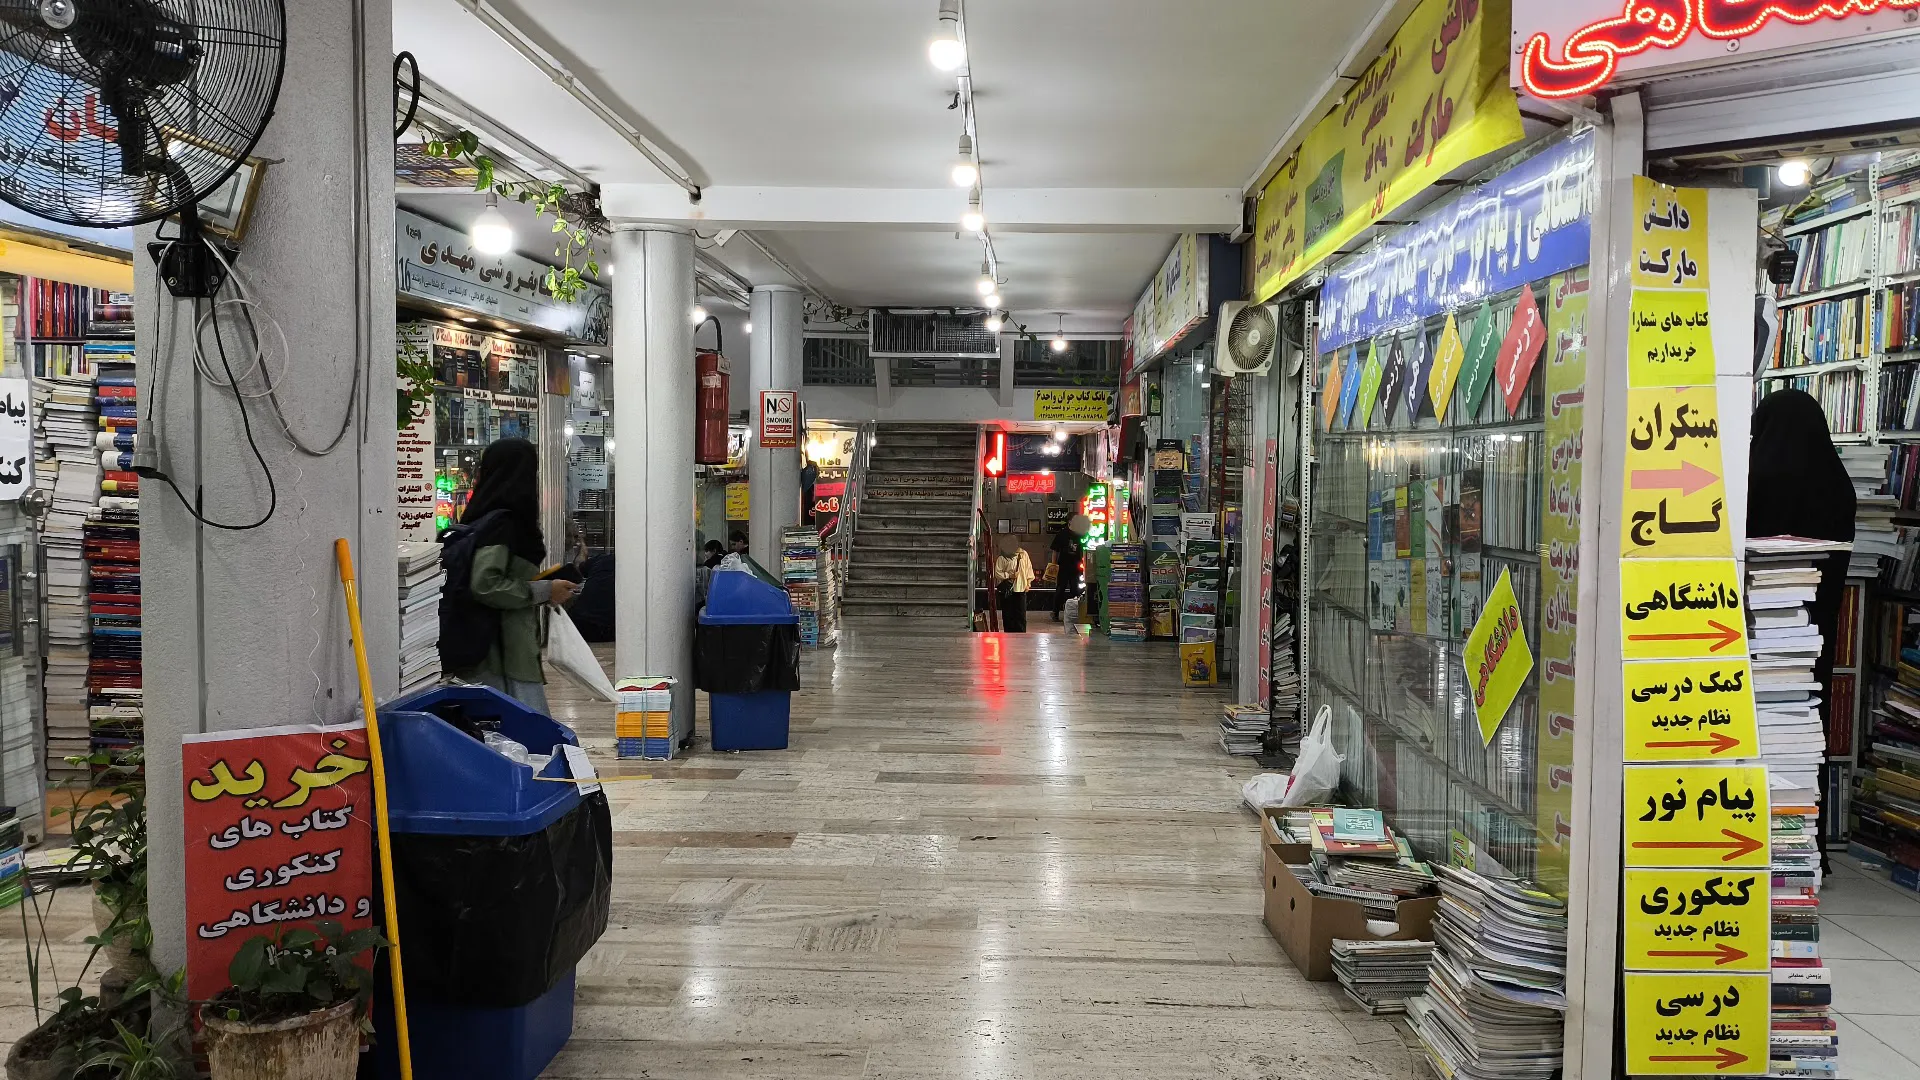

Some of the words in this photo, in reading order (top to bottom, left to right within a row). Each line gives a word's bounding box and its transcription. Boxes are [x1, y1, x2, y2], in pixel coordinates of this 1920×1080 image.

[1405, 78, 1453, 168] مارکت
[1644, 199, 1690, 231] دانش
[1486, 193, 1509, 276] پیام
[1512, 208, 1521, 270] و
[399, 256, 411, 293] 16
[1639, 249, 1697, 284] مارکت
[1660, 311, 1682, 332] های
[1685, 311, 1709, 330] کتاب
[1479, 315, 1493, 359] کمک
[1506, 308, 1535, 396] درسی
[1647, 342, 1697, 363] خریداریم
[1057, 390, 1074, 404] جوان
[1076, 391, 1090, 403] کتاب
[1092, 391, 1106, 404] بانک
[1465, 359, 1480, 404] درسی
[1630, 402, 1718, 451] مبتکران
[398, 485, 421, 494] انتشارات
[418, 495, 432, 503] کتاب
[1008, 476, 1034, 491] فوری
[1035, 478, 1054, 491] مهر
[400, 521, 421, 530] کامپیوتر
[414, 512, 433, 520] کتابهای
[1630, 497, 1722, 546] گاج
[1625, 582, 1739, 620] دانشگاهی
[1476, 605, 1518, 706] دانشگاهی
[1631, 676, 1693, 703] درسی
[1699, 670, 1744, 694] کمک
[1651, 712, 1693, 731] جدید
[1698, 709, 1731, 731] نظام
[189, 739, 370, 809] خرید
[1638, 777, 1687, 821] نور
[1697, 777, 1756, 824] پیام
[210, 815, 273, 850] های
[280, 805, 352, 840] کتاب
[224, 849, 342, 893] کنکوری
[352, 893, 371, 919] و
[1640, 876, 1755, 915] کنکوری
[197, 891, 346, 940] دانشگاهی
[1703, 920, 1740, 942] نظام
[1654, 923, 1698, 941] جدید
[1656, 985, 1740, 1017] درسی
[1655, 1027, 1698, 1045] جدید
[1703, 1023, 1740, 1046] نظام
